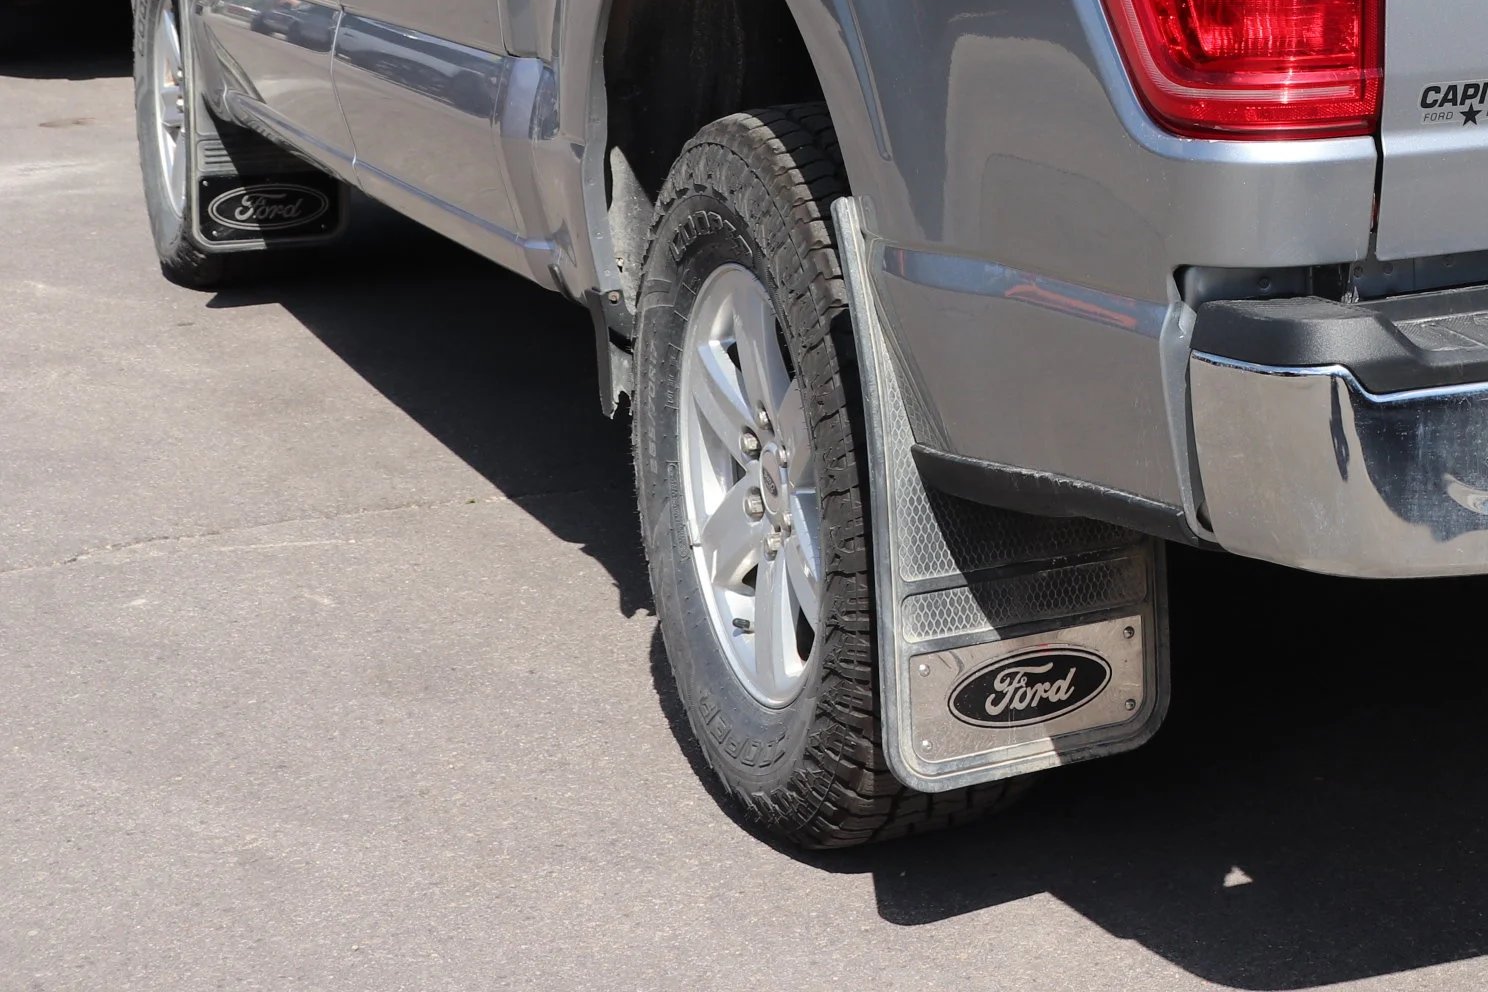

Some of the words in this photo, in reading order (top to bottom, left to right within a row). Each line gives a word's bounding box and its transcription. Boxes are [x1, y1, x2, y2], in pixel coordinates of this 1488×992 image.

[1423, 111, 1454, 122] FORD
[234, 193, 303, 221] Ford
[984, 661, 1077, 716] Ford
